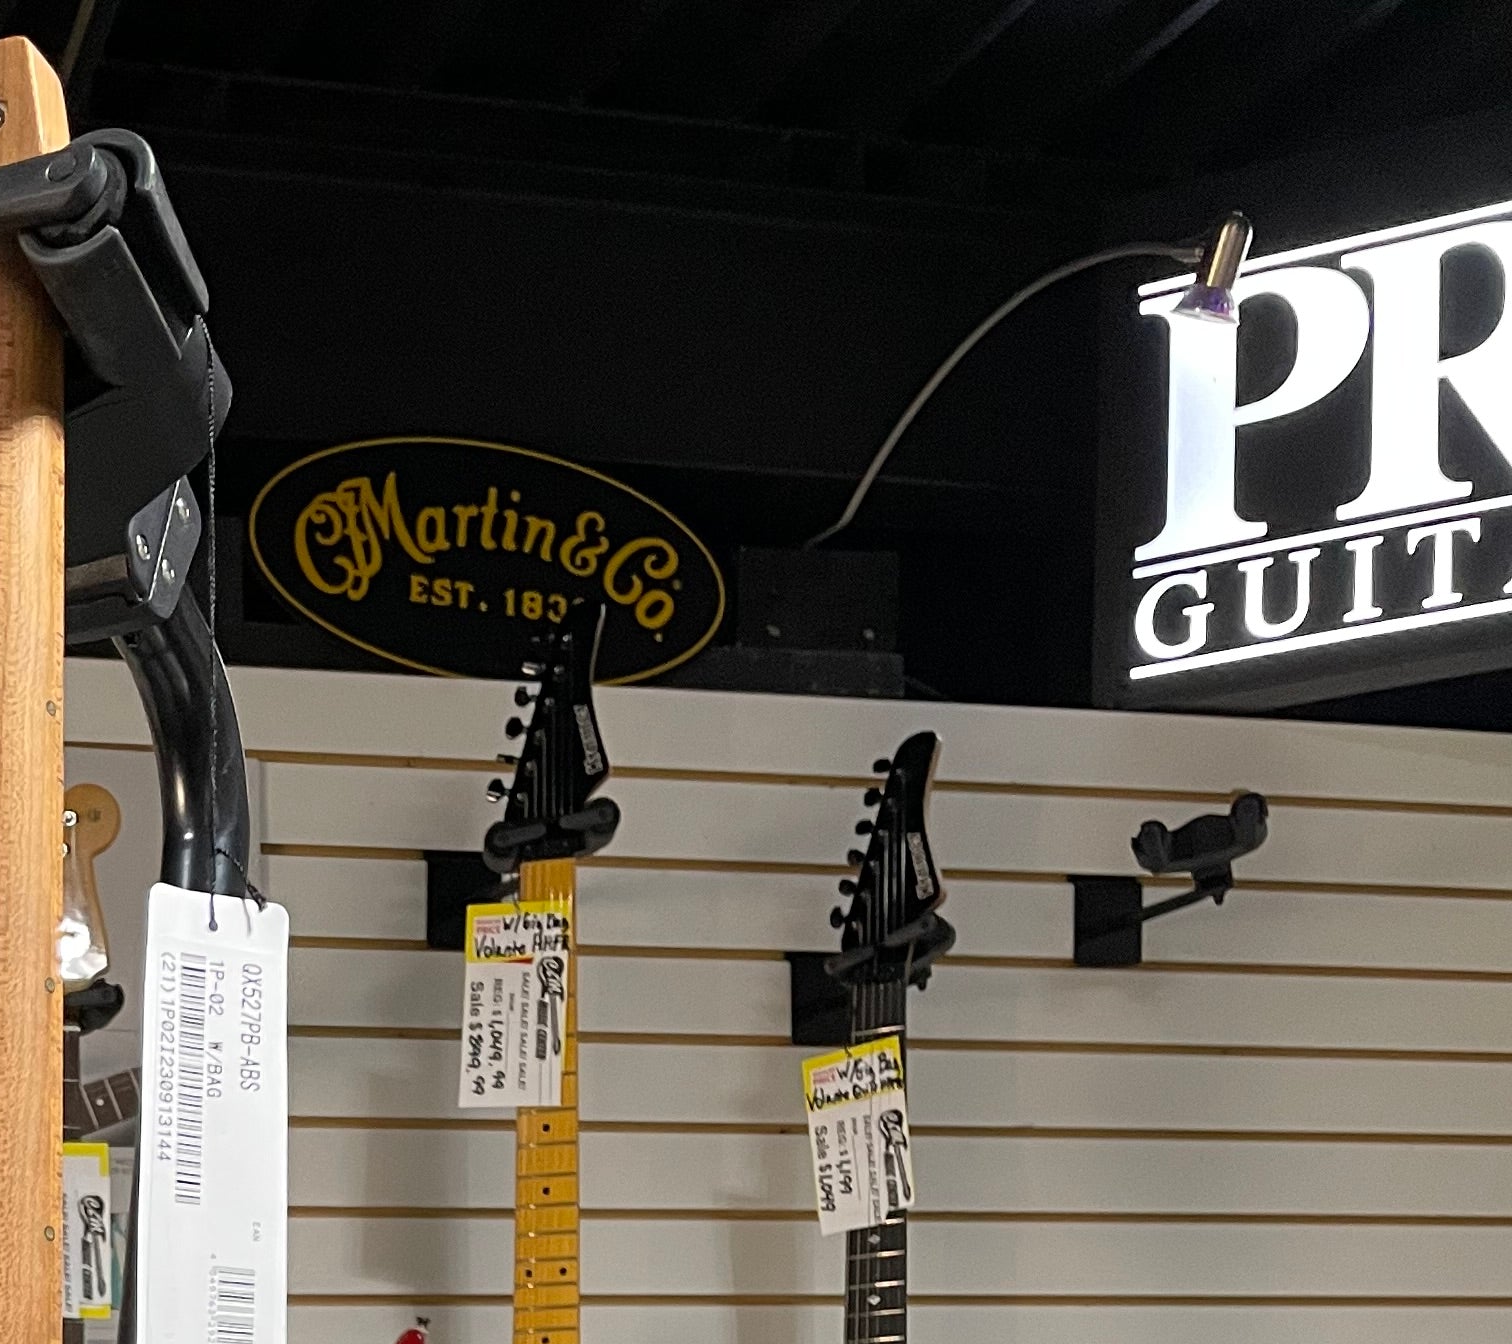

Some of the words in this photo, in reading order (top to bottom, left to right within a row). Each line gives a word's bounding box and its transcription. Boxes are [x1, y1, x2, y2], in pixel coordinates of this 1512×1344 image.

[410, 572, 487, 613] EST.
[504, 588, 586, 624] 183
[1133, 517, 1512, 660] GUIT
[208, 960, 225, 1017] 1P-02
[470, 981, 484, 1017] Sale
[240, 962, 263, 1093] QX527PB-ABS
[206, 1041, 223, 1099] W/BAG
[814, 1125, 829, 1160] Sale
[252, 1221, 262, 1242] EAN
